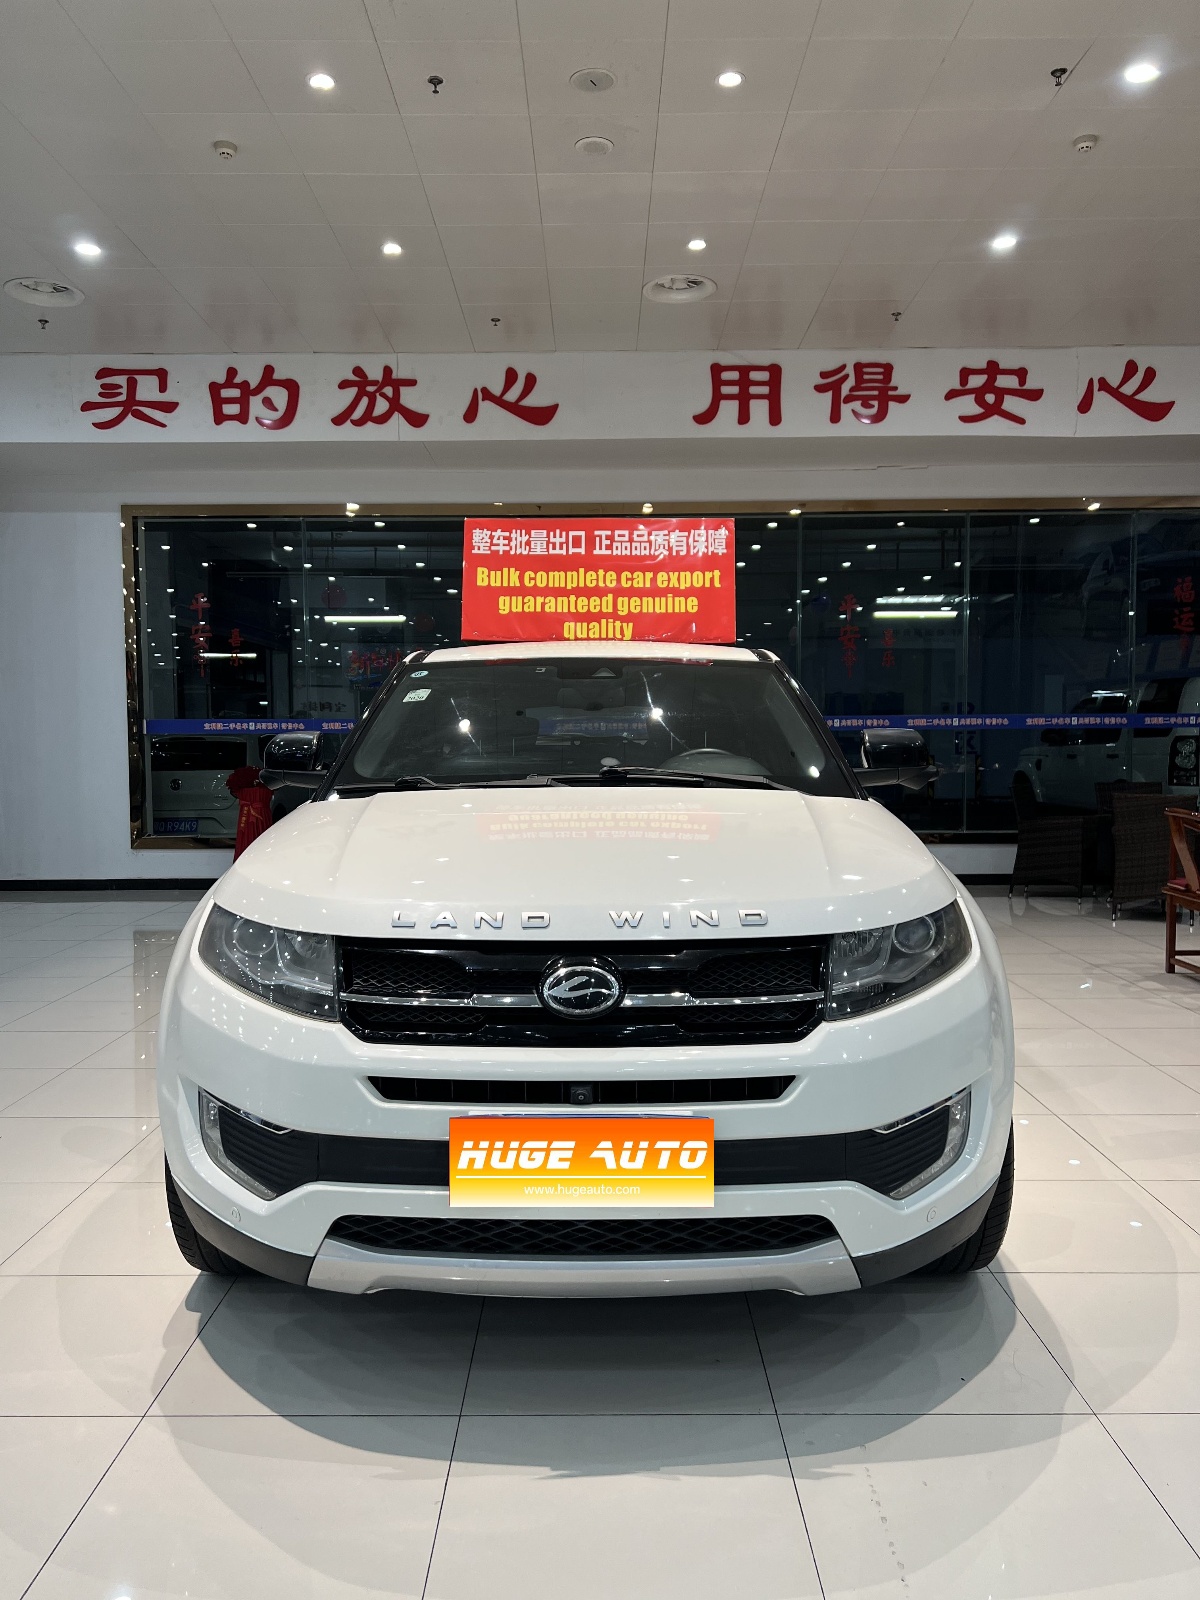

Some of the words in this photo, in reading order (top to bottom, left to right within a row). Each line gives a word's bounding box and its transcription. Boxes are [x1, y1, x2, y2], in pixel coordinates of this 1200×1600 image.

[80, 364, 560, 431] 买的放心
[692, 359, 1176, 427] 用得安心
[471, 528, 586, 555] 整车批量出口
[593, 528, 728, 556] 正品品质有保障
[476, 567, 520, 587] Bulk
[524, 567, 617, 590] complete
[620, 571, 654, 588] car
[656, 569, 721, 590] export
[498, 593, 613, 615] guaranteed
[617, 593, 699, 616] genuine
[563, 618, 633, 641] quality
[391, 909, 551, 929] LAND
[608, 908, 770, 928] WIND
